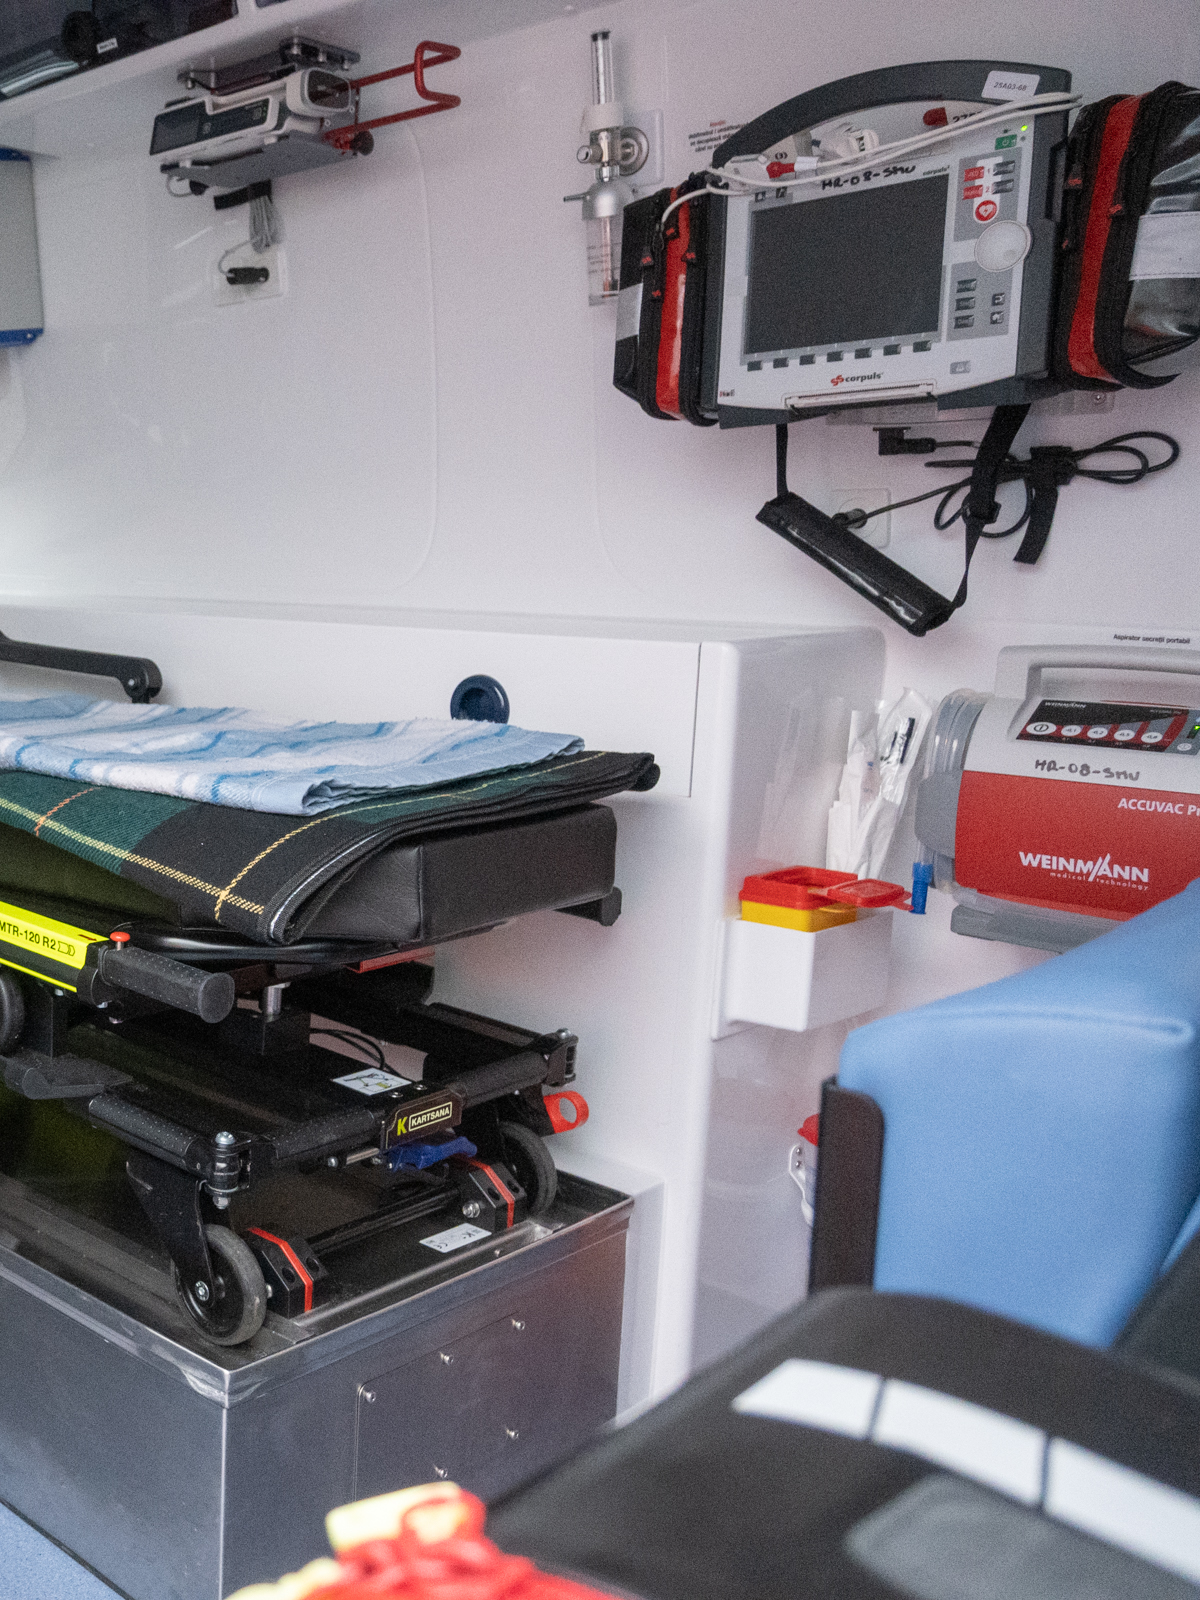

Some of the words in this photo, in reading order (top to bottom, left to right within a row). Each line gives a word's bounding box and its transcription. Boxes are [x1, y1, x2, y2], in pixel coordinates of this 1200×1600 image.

[845, 372, 881, 383] corpuls
[1118, 798, 1184, 815] ACCUVAC
[1019, 851, 1149, 882] WEINMANN
[1050, 872, 1086, 881] medical
[1096, 877, 1149, 891] technology
[42, 936, 56, 951] R2
[397, 1116, 408, 1136] K
[411, 1107, 450, 1127] KARTSANA
